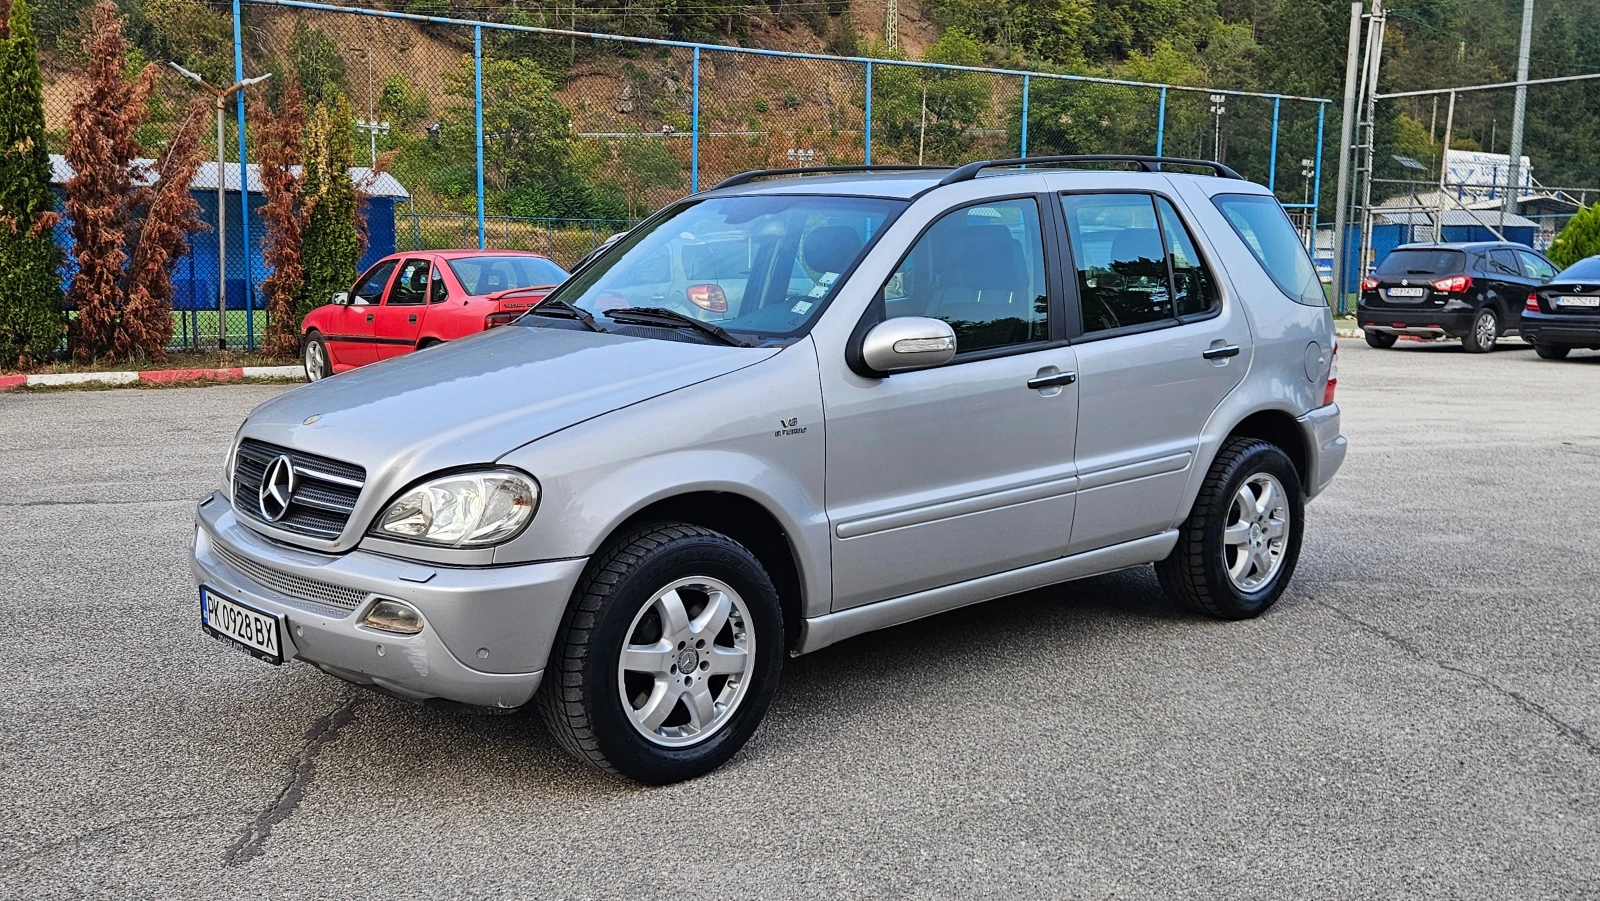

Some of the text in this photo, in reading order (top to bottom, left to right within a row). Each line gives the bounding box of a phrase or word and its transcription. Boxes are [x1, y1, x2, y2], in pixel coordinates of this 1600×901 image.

[780, 417, 798, 428] V8
[207, 595, 221, 627] PK
[223, 604, 253, 641] 0928
[254, 616, 275, 651] BX
